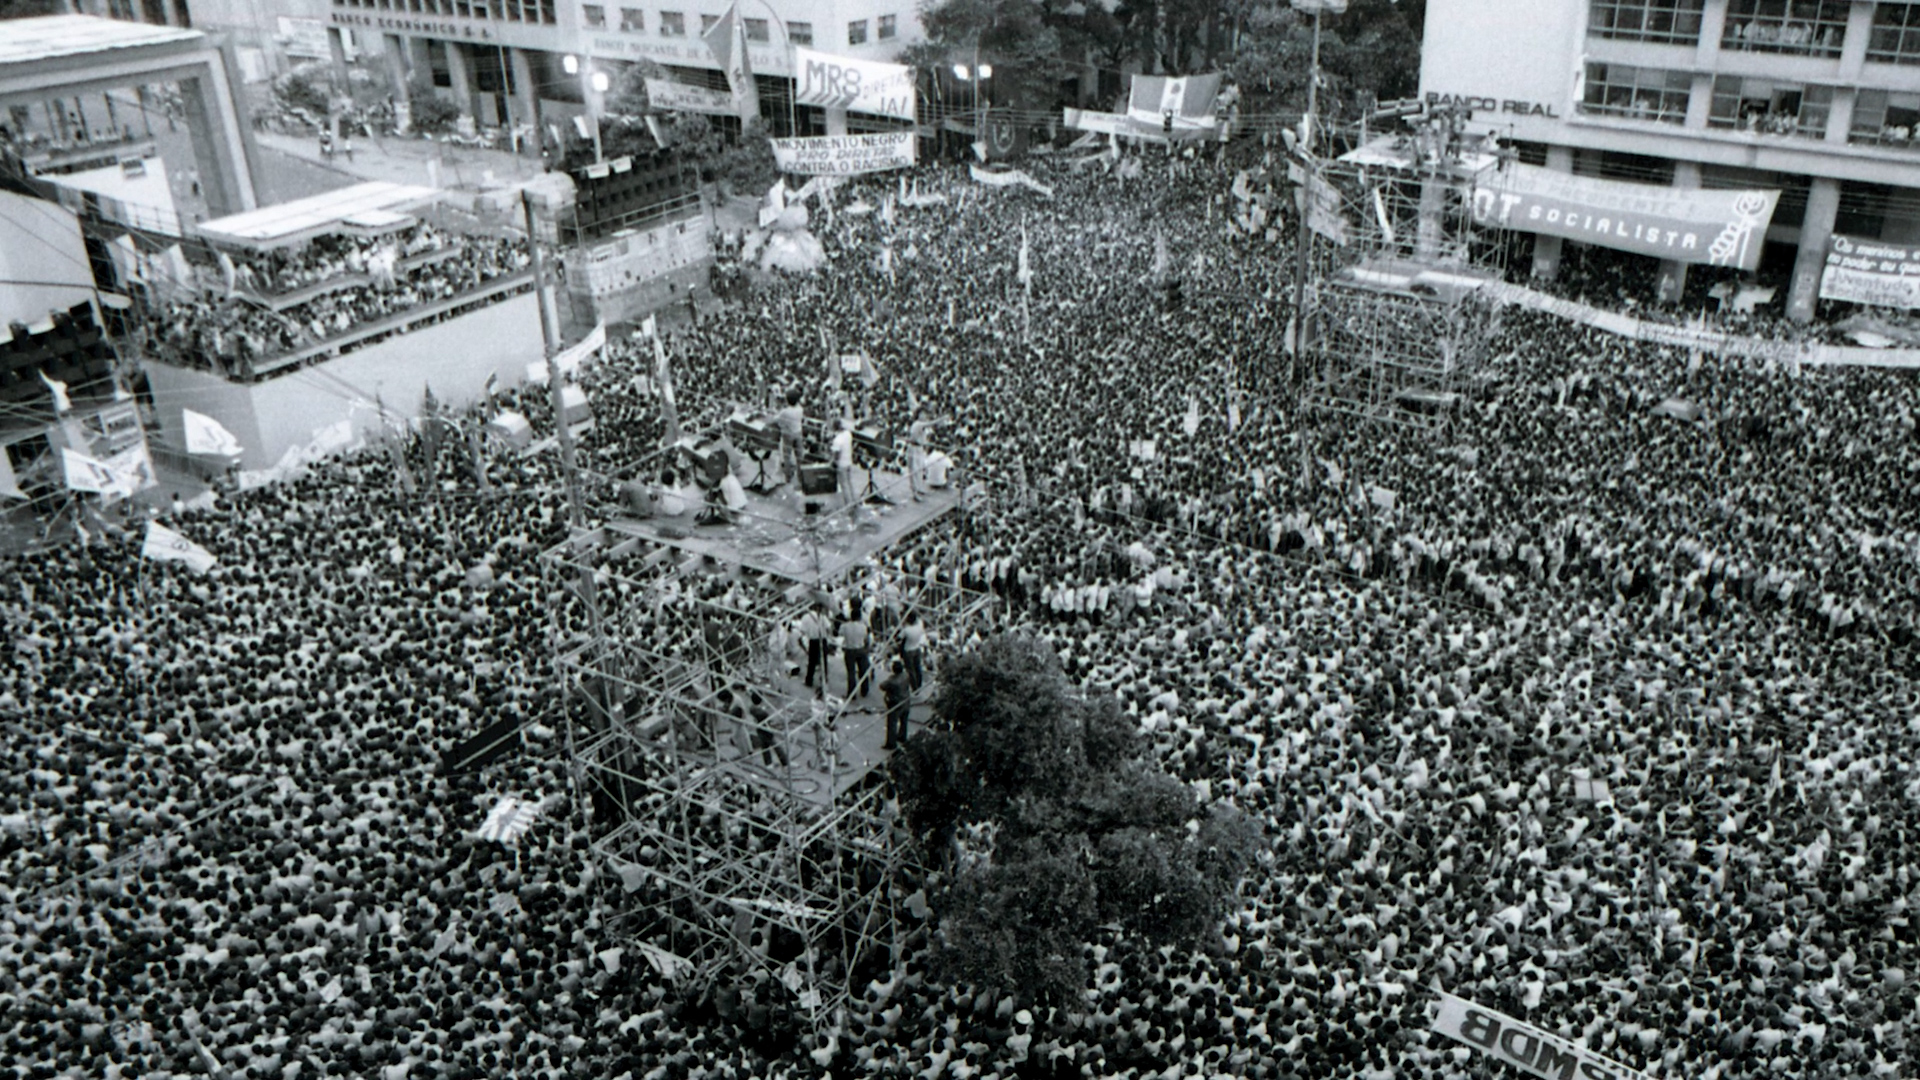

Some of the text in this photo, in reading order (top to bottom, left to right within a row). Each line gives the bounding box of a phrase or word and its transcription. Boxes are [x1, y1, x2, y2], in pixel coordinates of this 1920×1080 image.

[799, 60, 861, 104] MR8
[1425, 91, 1559, 118] BANCO REAL
[777, 133, 907, 150] MOVIMENTO NEGRO
[836, 146, 896, 160] DIRETAS
[785, 155, 908, 174] CONTRA O RACISMO
[1529, 205, 1697, 249] SOCIALISTA
